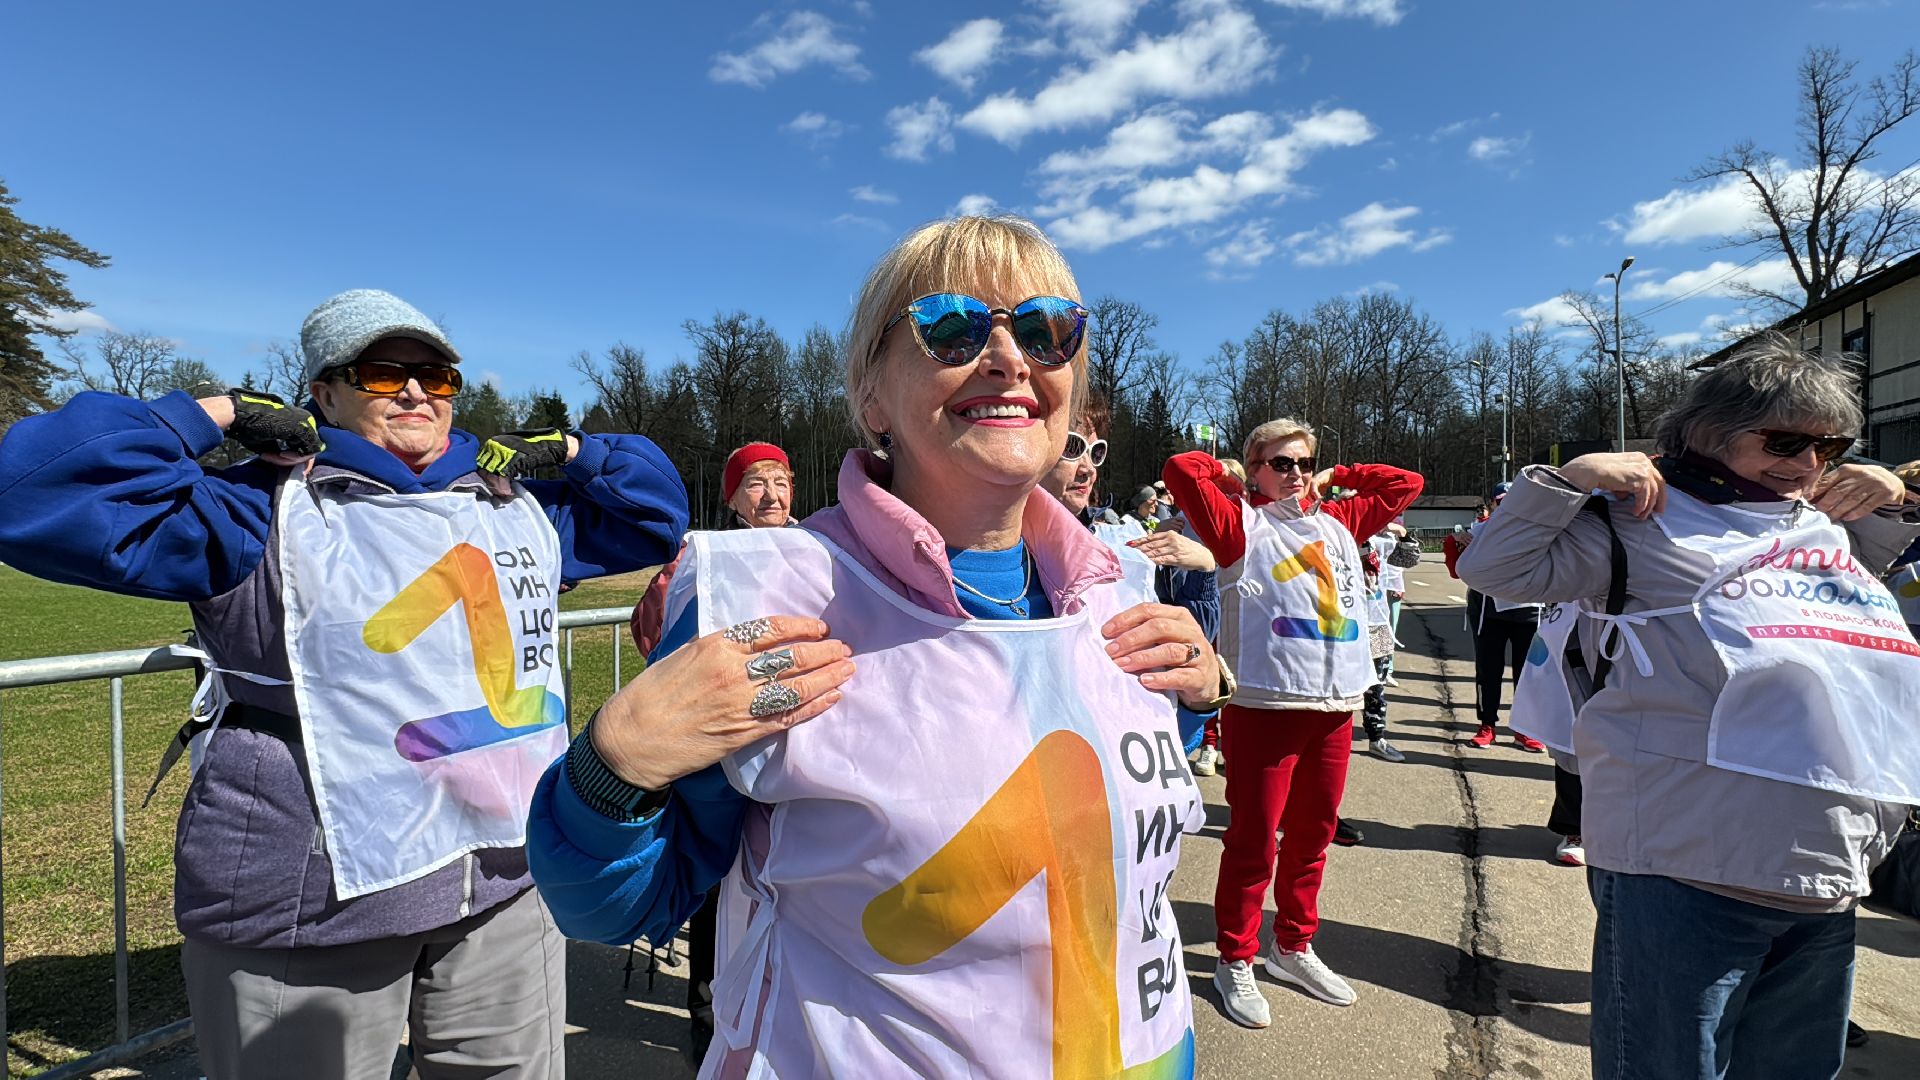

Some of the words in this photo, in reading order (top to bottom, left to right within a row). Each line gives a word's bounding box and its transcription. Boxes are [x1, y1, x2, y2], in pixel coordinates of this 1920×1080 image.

[494, 546, 537, 569] ОД
[508, 575, 551, 600] ИН
[520, 608, 553, 638] ЦО
[1756, 626, 1832, 638] ПРОЕКТ
[1120, 731, 1192, 789] ОД
